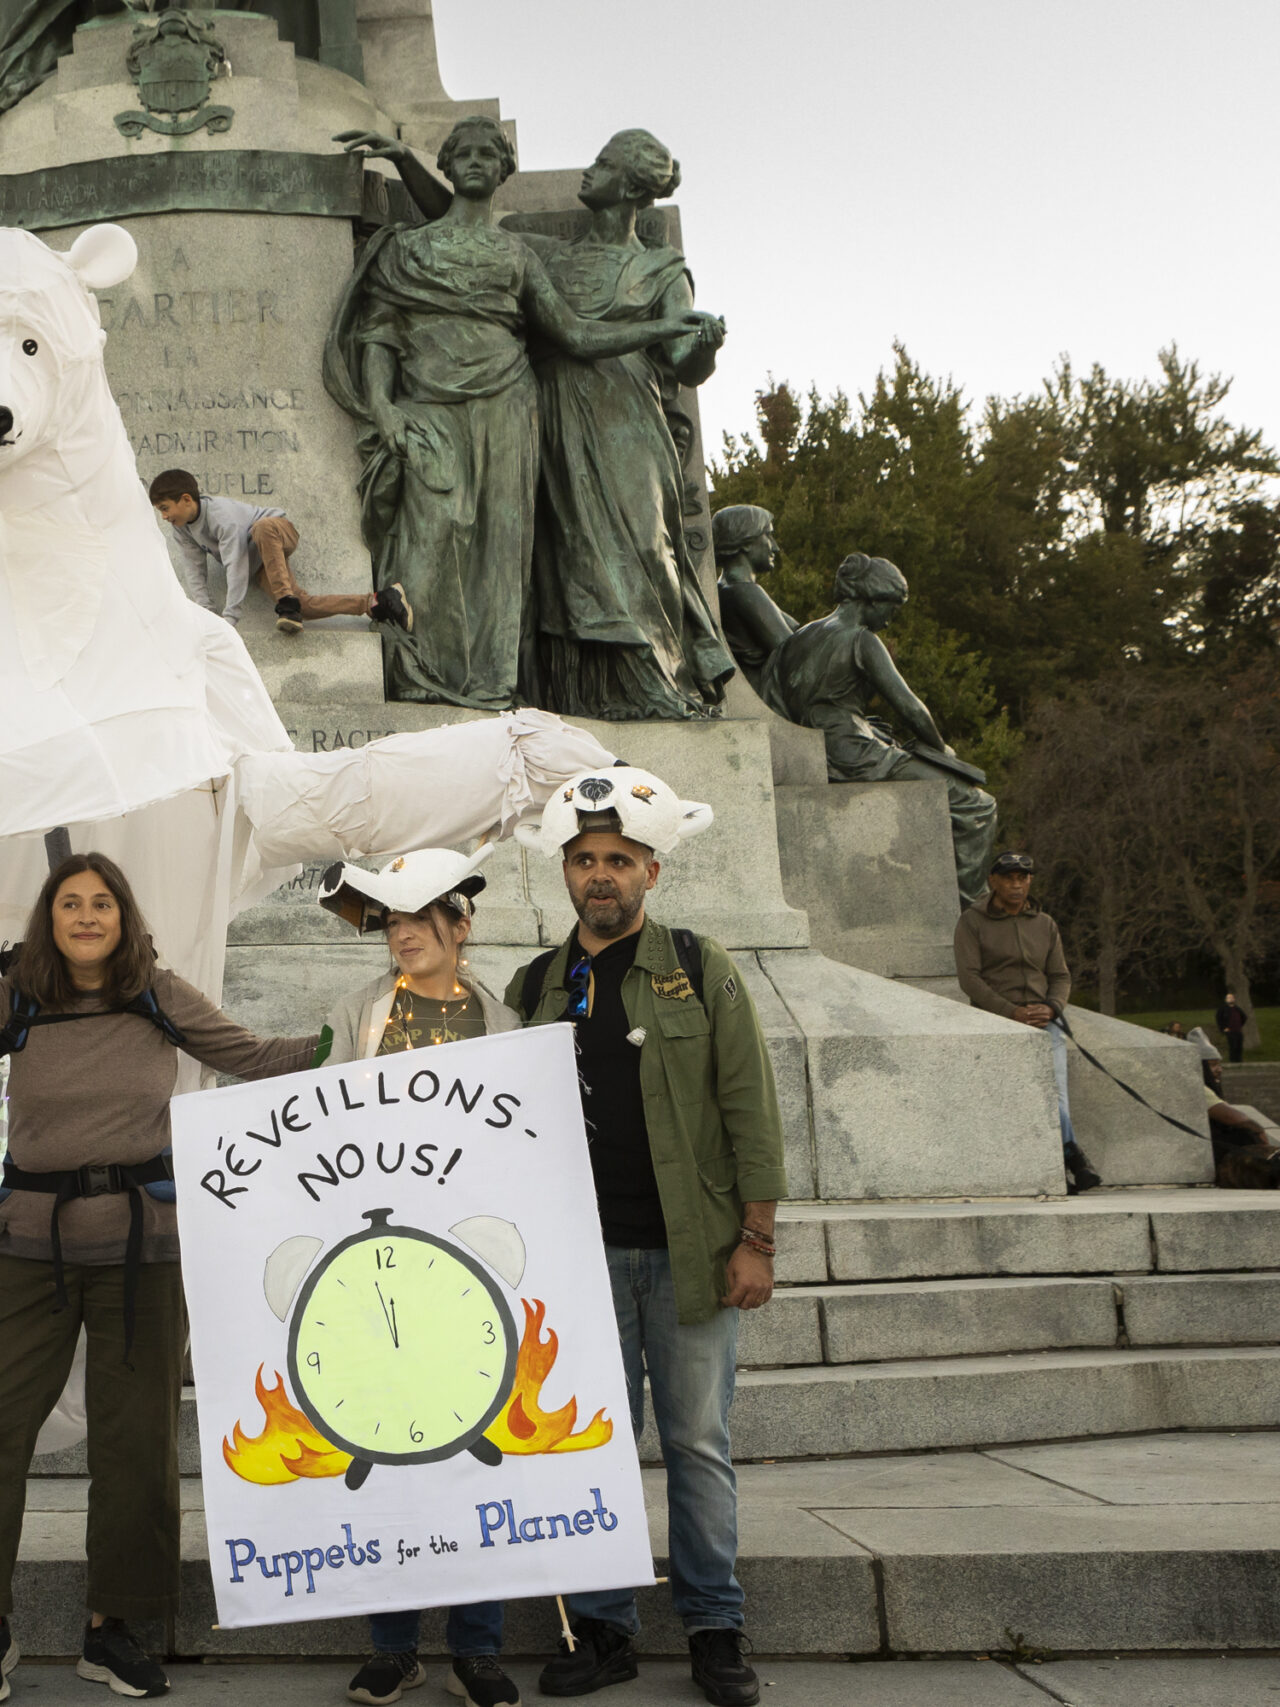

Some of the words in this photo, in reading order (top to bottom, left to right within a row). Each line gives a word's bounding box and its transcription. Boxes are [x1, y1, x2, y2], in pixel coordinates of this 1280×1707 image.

[312, 729, 397, 752] RACE
[382, 1028, 423, 1047] AMP
[297, 1141, 463, 1202] NOUS!
[374, 1245, 398, 1271] 12
[481, 1320, 497, 1345] 3
[306, 1351, 322, 1375] 9
[409, 1420, 424, 1444] 6
[225, 1523, 383, 1598] Puppets
[397, 1539, 421, 1566] for
[429, 1535, 459, 1556] the
[476, 1488, 619, 1549] Planet
